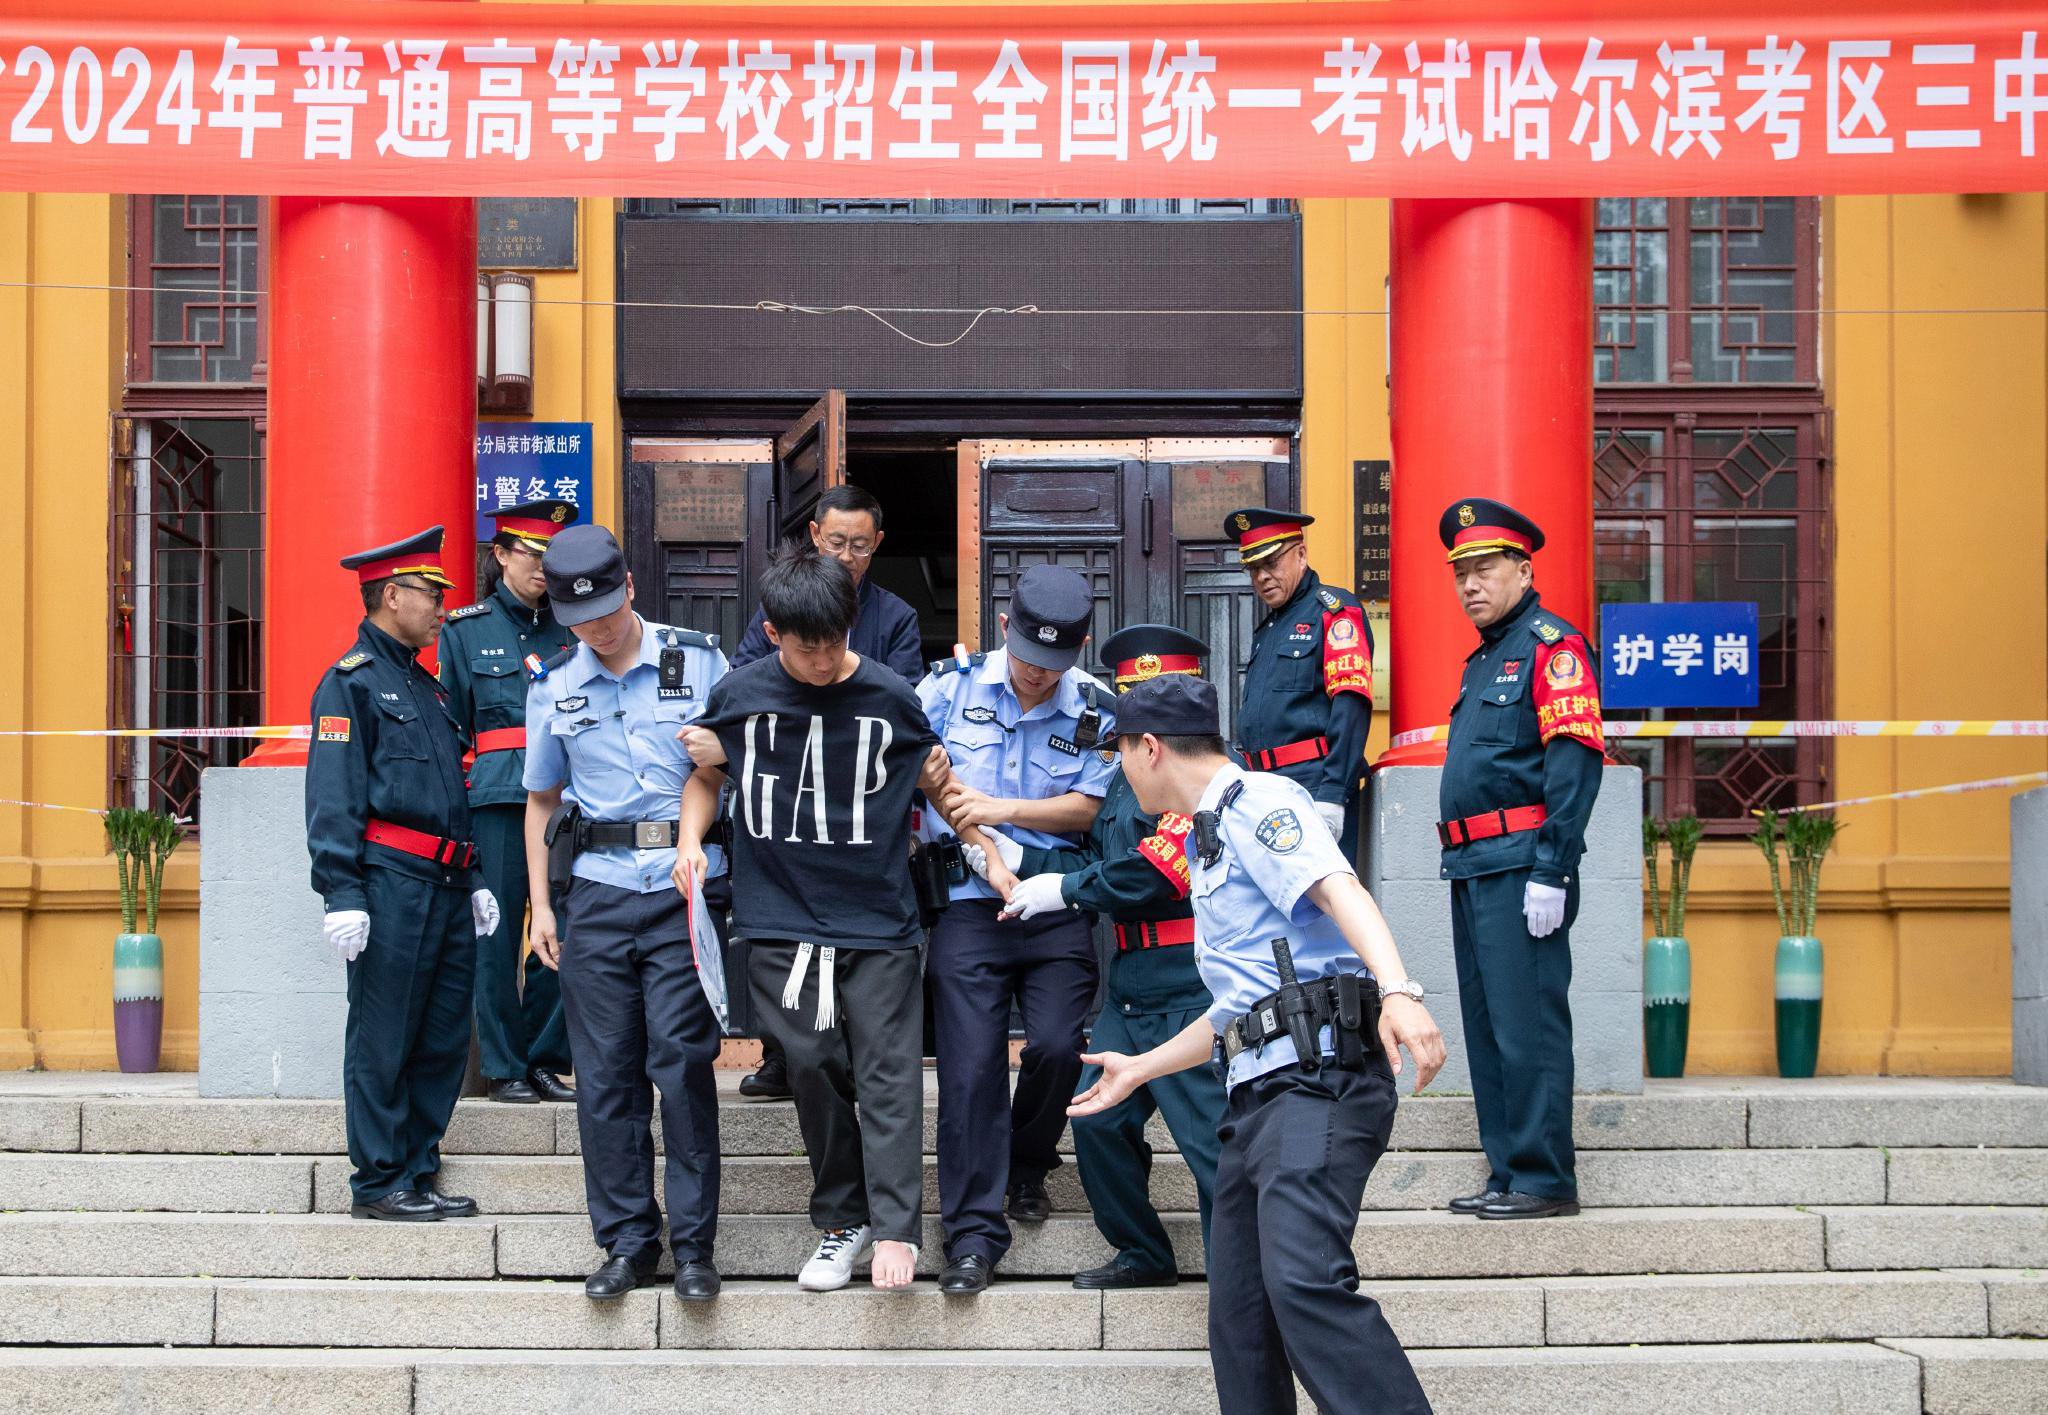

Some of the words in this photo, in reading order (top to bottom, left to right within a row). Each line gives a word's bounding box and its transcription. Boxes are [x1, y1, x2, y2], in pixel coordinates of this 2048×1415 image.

[0, 31, 2048, 162] 2024年普通高等学校招生全国统一考试哈尔滨考区三中
[1362, 503, 1390, 515] 建设单
[1362, 525, 1390, 536] 施工单
[1612, 632, 1750, 676] 护学岗
[1794, 720, 1826, 736] LIMIT
[741, 713, 893, 845] GAP
[823, 946, 833, 962] EST
